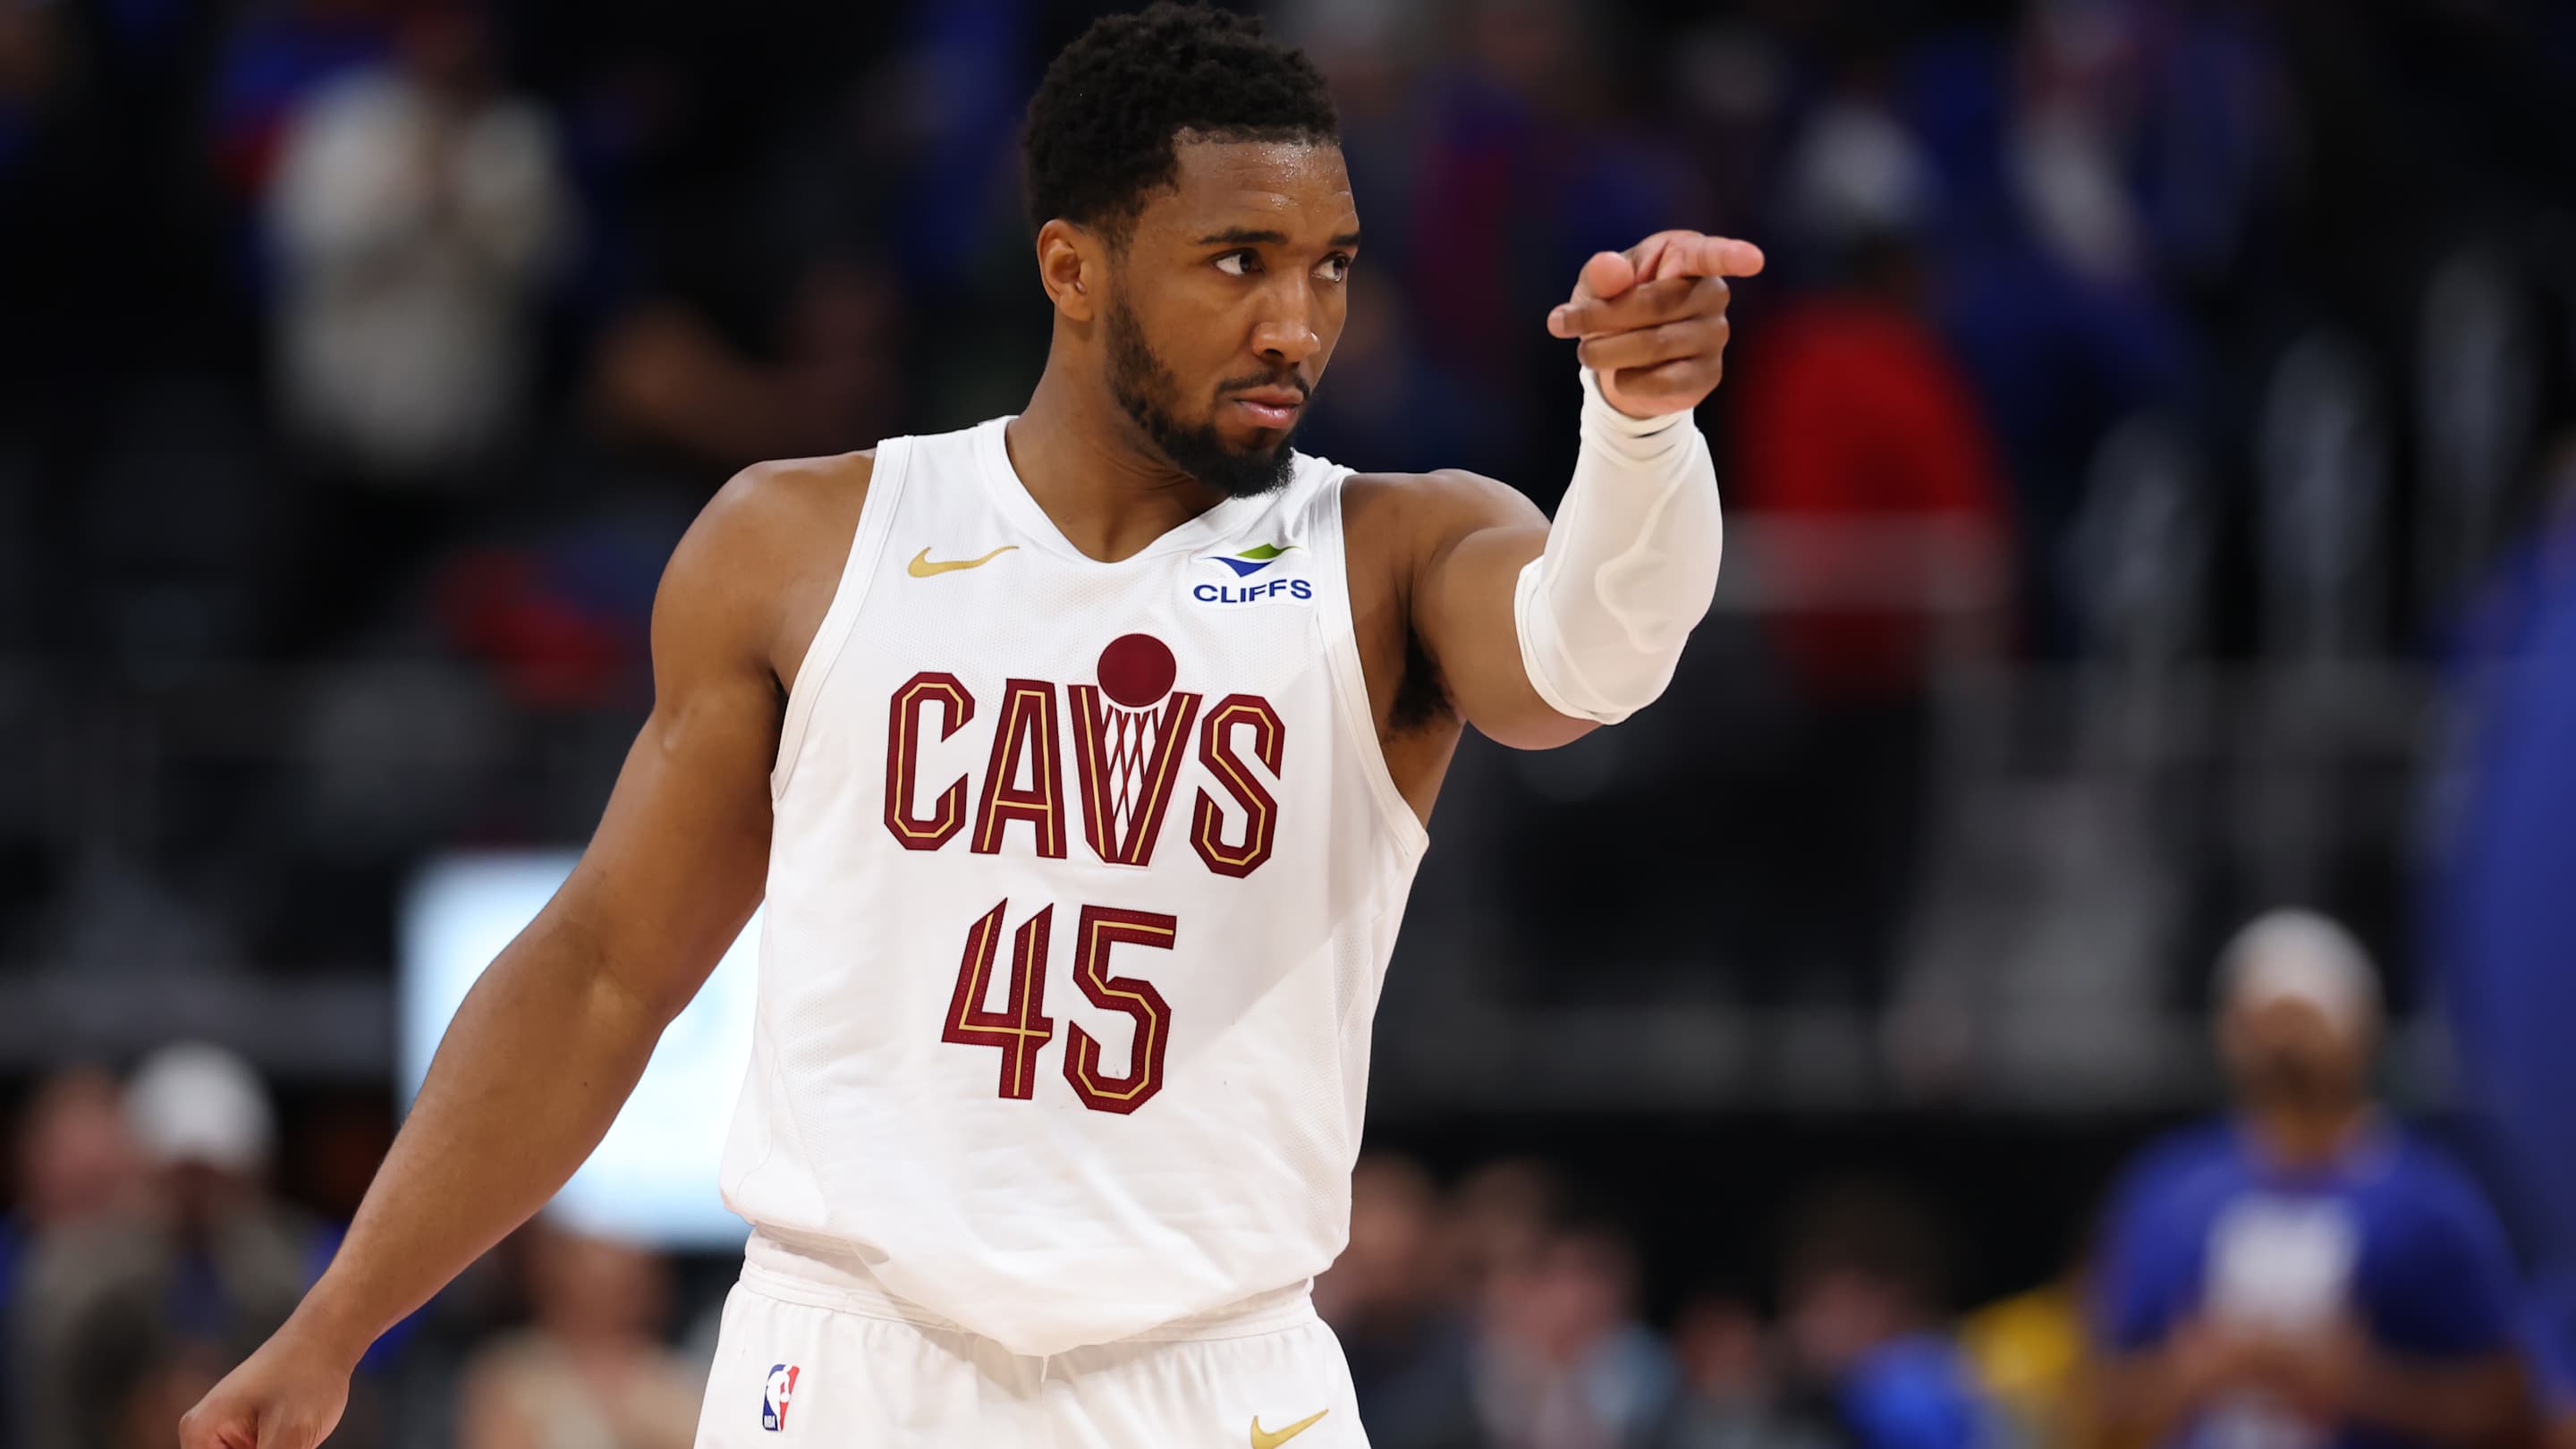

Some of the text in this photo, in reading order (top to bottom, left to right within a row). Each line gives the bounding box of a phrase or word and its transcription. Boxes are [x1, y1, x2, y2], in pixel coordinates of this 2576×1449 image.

[1193, 579, 1312, 603] CLIFFS
[884, 672, 1285, 878] CAVS
[941, 897, 1177, 1115] 45
